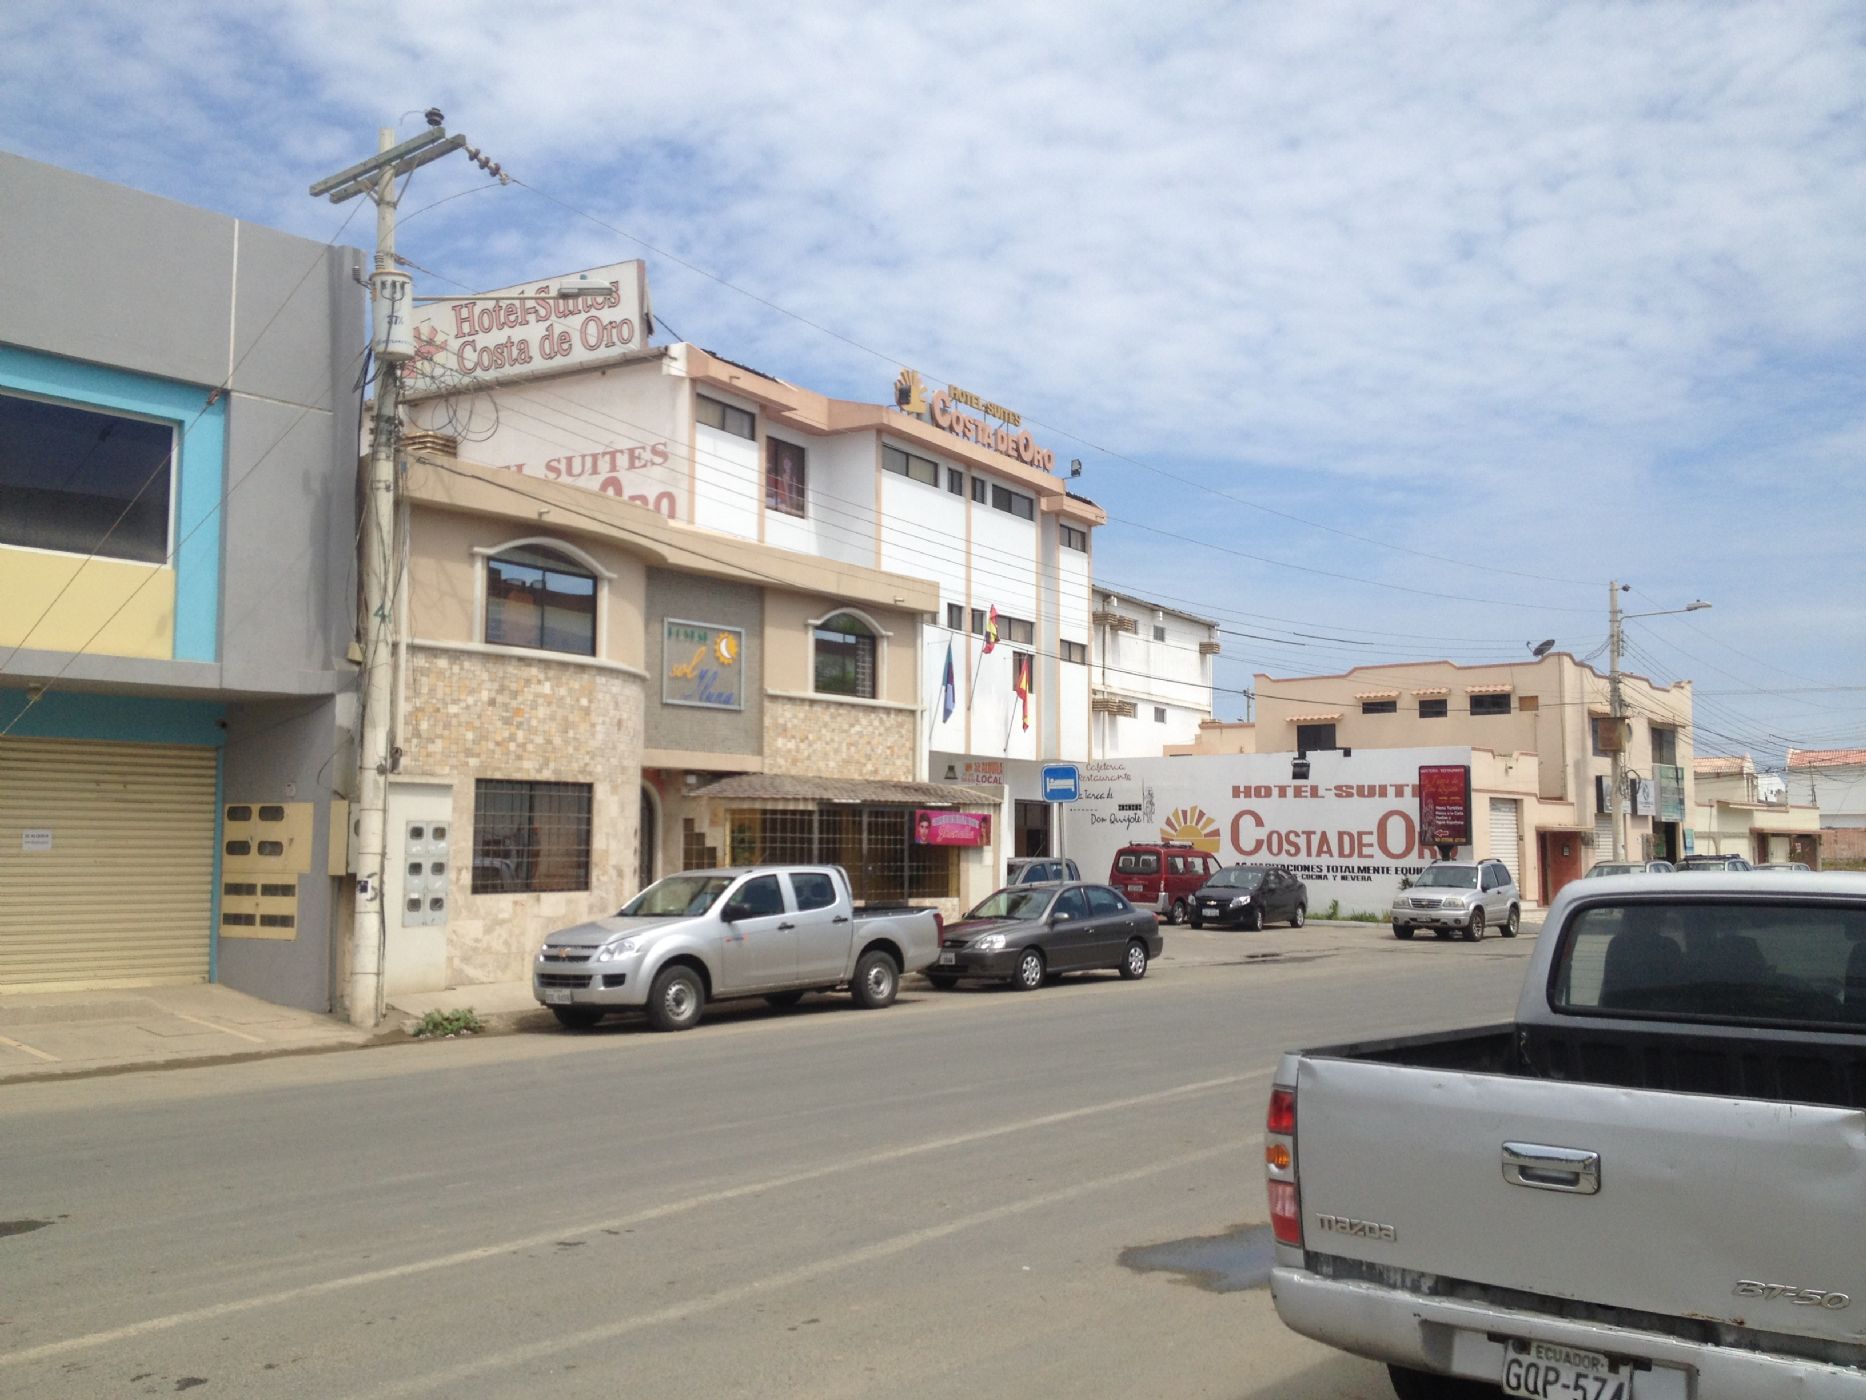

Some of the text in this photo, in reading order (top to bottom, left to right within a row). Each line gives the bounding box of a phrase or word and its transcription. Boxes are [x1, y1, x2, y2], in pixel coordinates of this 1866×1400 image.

[457, 315, 635, 376] Costa de Oro
[544, 441, 670, 481] SUITES
[975, 774, 1003, 785] LOCAL
[1230, 809, 1334, 859] COSTA
[1337, 831, 1374, 859] DE
[1326, 865, 1391, 875] TOTALMENTE
[1341, 874, 1372, 882] NEVERA
[1732, 1279, 1850, 1311] BT-50
[1534, 1343, 1602, 1371] ECUADOR
